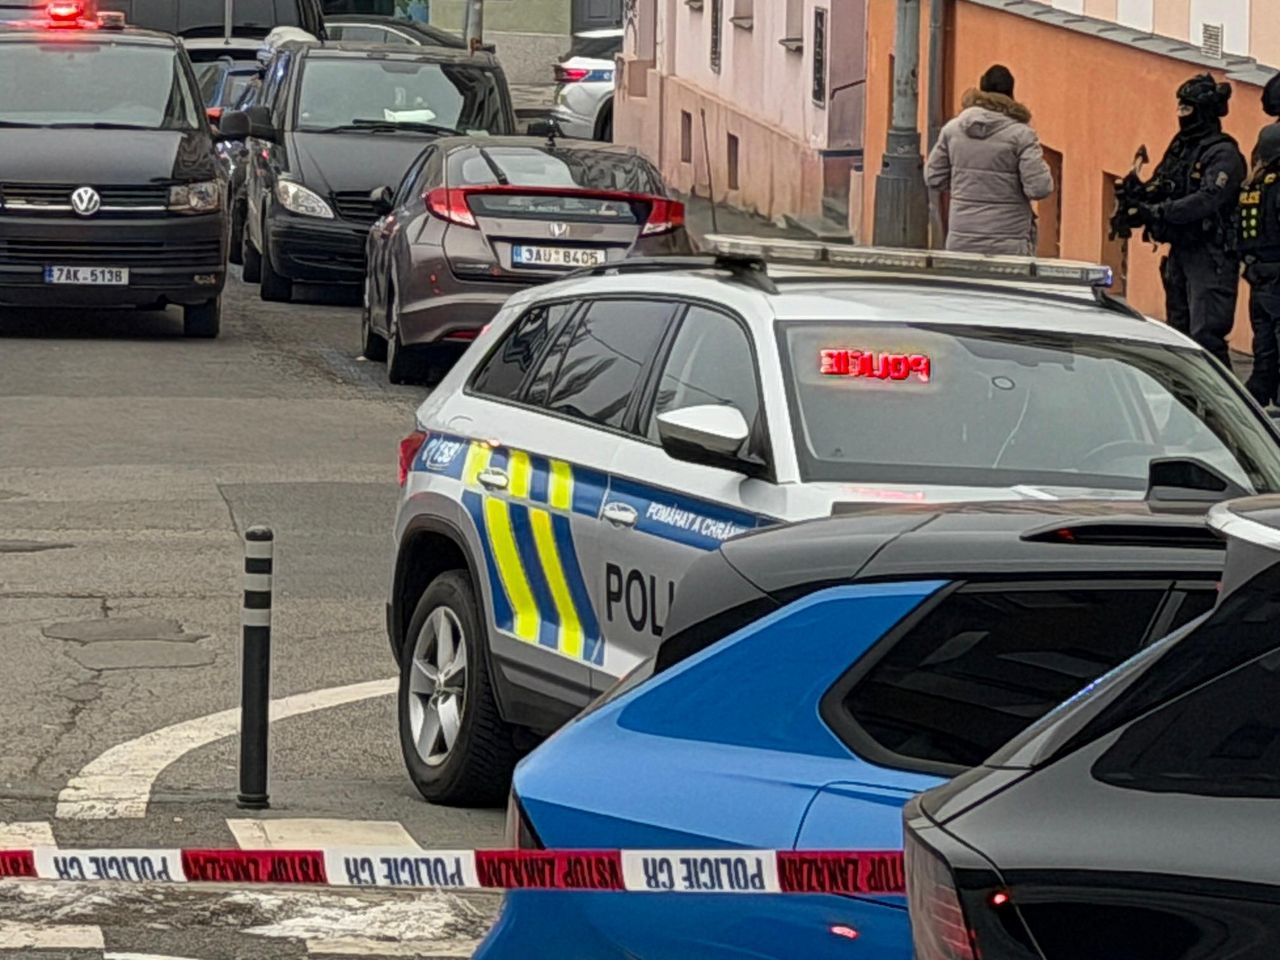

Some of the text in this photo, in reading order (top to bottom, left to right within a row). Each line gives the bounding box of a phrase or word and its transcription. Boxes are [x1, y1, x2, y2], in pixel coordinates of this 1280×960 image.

[646, 502, 693, 530] POMÁHAT
[605, 562, 674, 637] POLI
[89, 856, 170, 880] POLICIE
[380, 857, 465, 886] POLICIE
[680, 857, 766, 890] POLICIE
[866, 856, 905, 893] TUP
